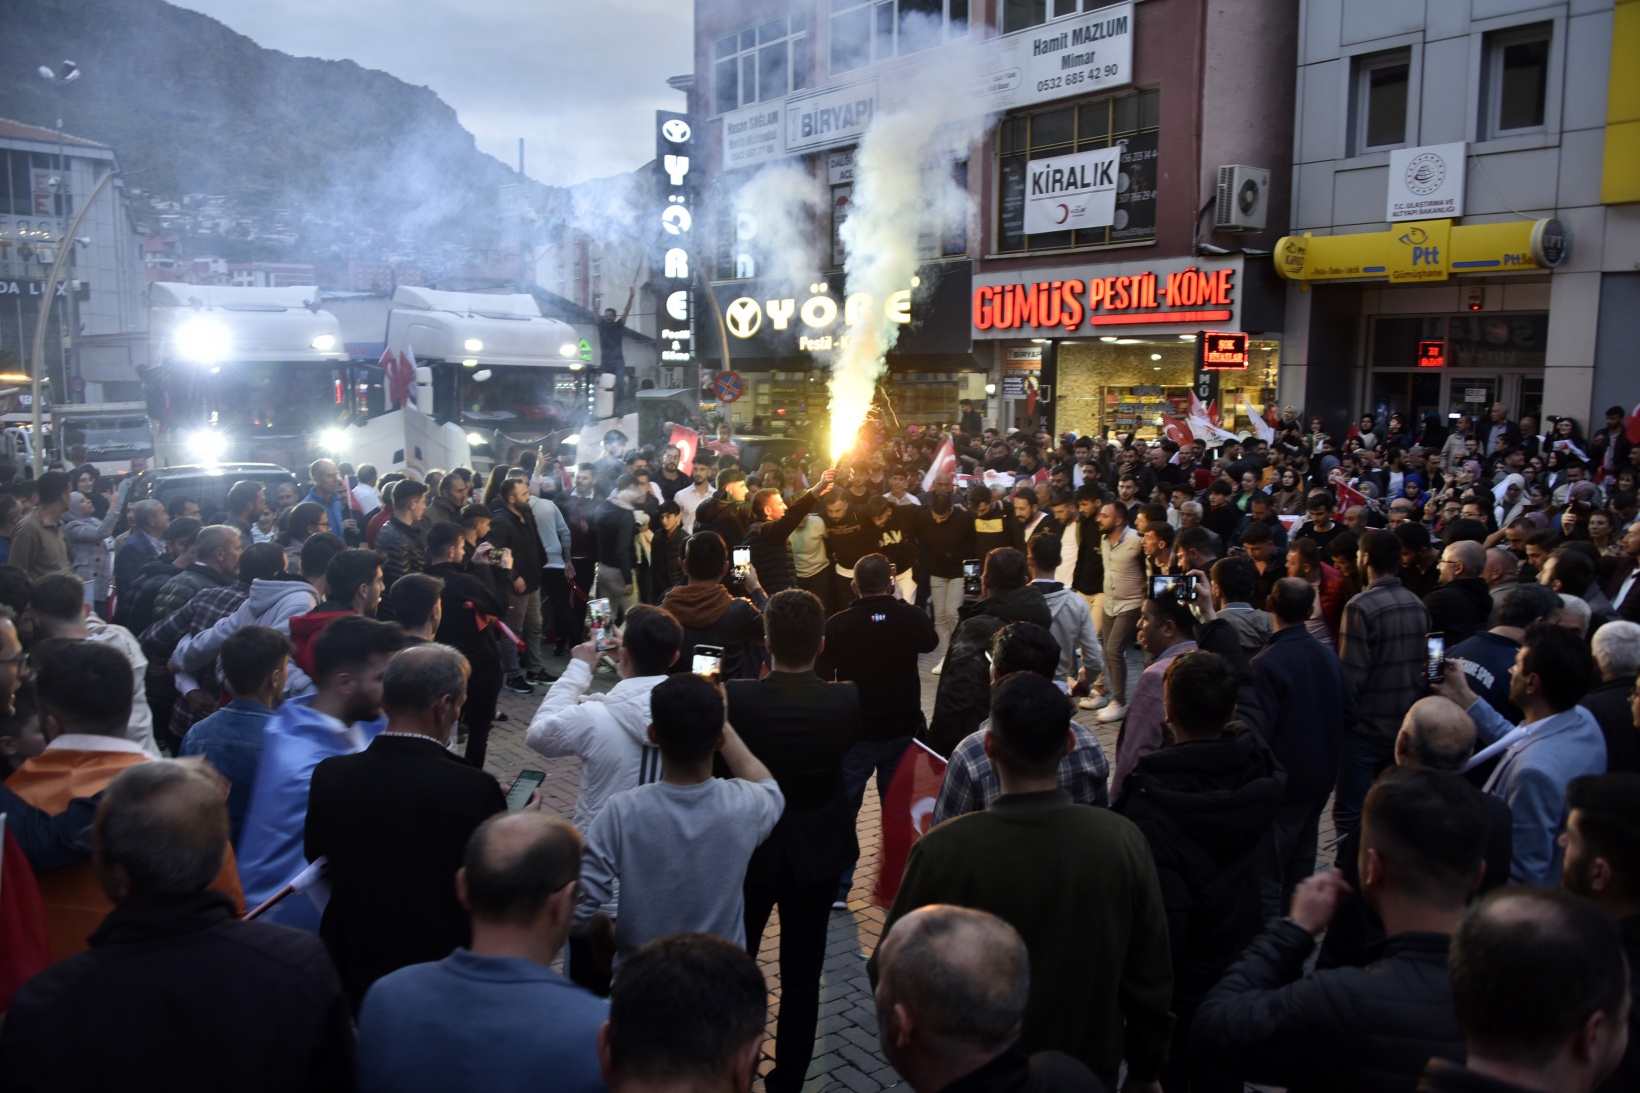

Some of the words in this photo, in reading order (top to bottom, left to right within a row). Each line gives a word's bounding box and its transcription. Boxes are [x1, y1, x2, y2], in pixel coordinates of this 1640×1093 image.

[1033, 32, 1068, 56] Hamit
[1072, 15, 1128, 47] MAZLUM
[1061, 51, 1096, 70] Mimar
[1037, 76, 1062, 93] 0532
[1065, 71, 1085, 86] 685
[1088, 67, 1101, 80] 42
[1104, 63, 1119, 77] 90
[801, 97, 873, 138] BİRYAPI
[1032, 158, 1115, 196] KİRALIK
[1392, 209, 1418, 218] ALTYAPI
[661, 154, 691, 321] YÖRE
[1544, 234, 1563, 248] UPT
[1412, 246, 1440, 266] Ptt
[1393, 269, 1444, 280] Gümüşhane
[973, 279, 1084, 331] GÜMÜŞ
[1090, 267, 1235, 311] PESTİL-KÖME
[799, 336, 832, 351] Pestil
[1218, 340, 1236, 351] ŞOK
[1013, 350, 1042, 358] BİRYAP
